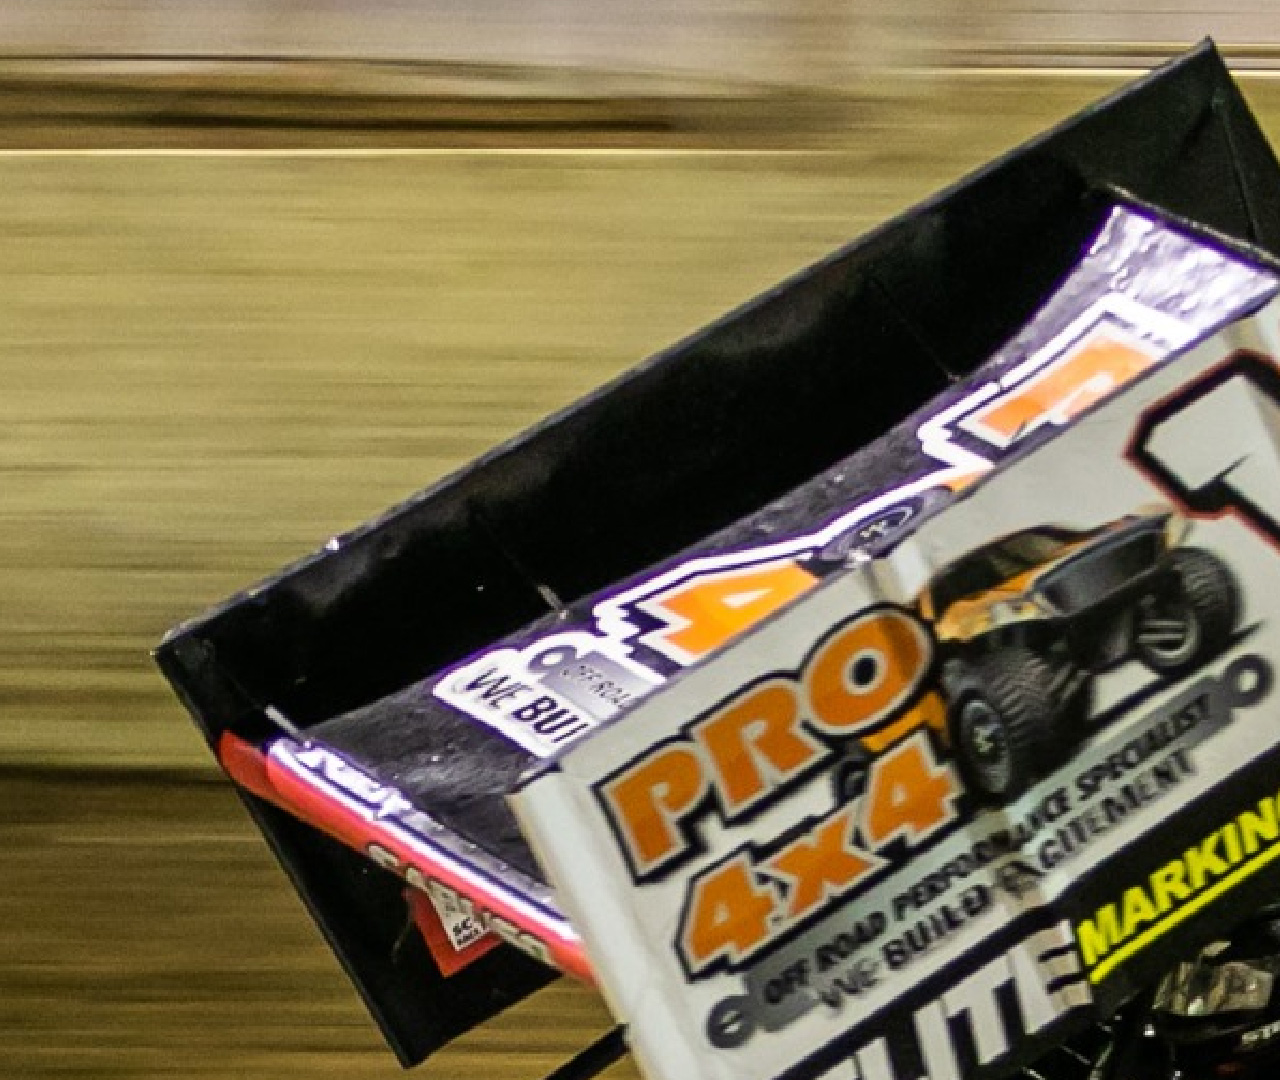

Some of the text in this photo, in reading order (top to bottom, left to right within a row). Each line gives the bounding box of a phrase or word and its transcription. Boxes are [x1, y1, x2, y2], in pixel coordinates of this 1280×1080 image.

[592, 606, 932, 884] PRO
[764, 960, 813, 1006] OFF
[816, 910, 886, 974] ROAD
[883, 882, 995, 973] BUILD
